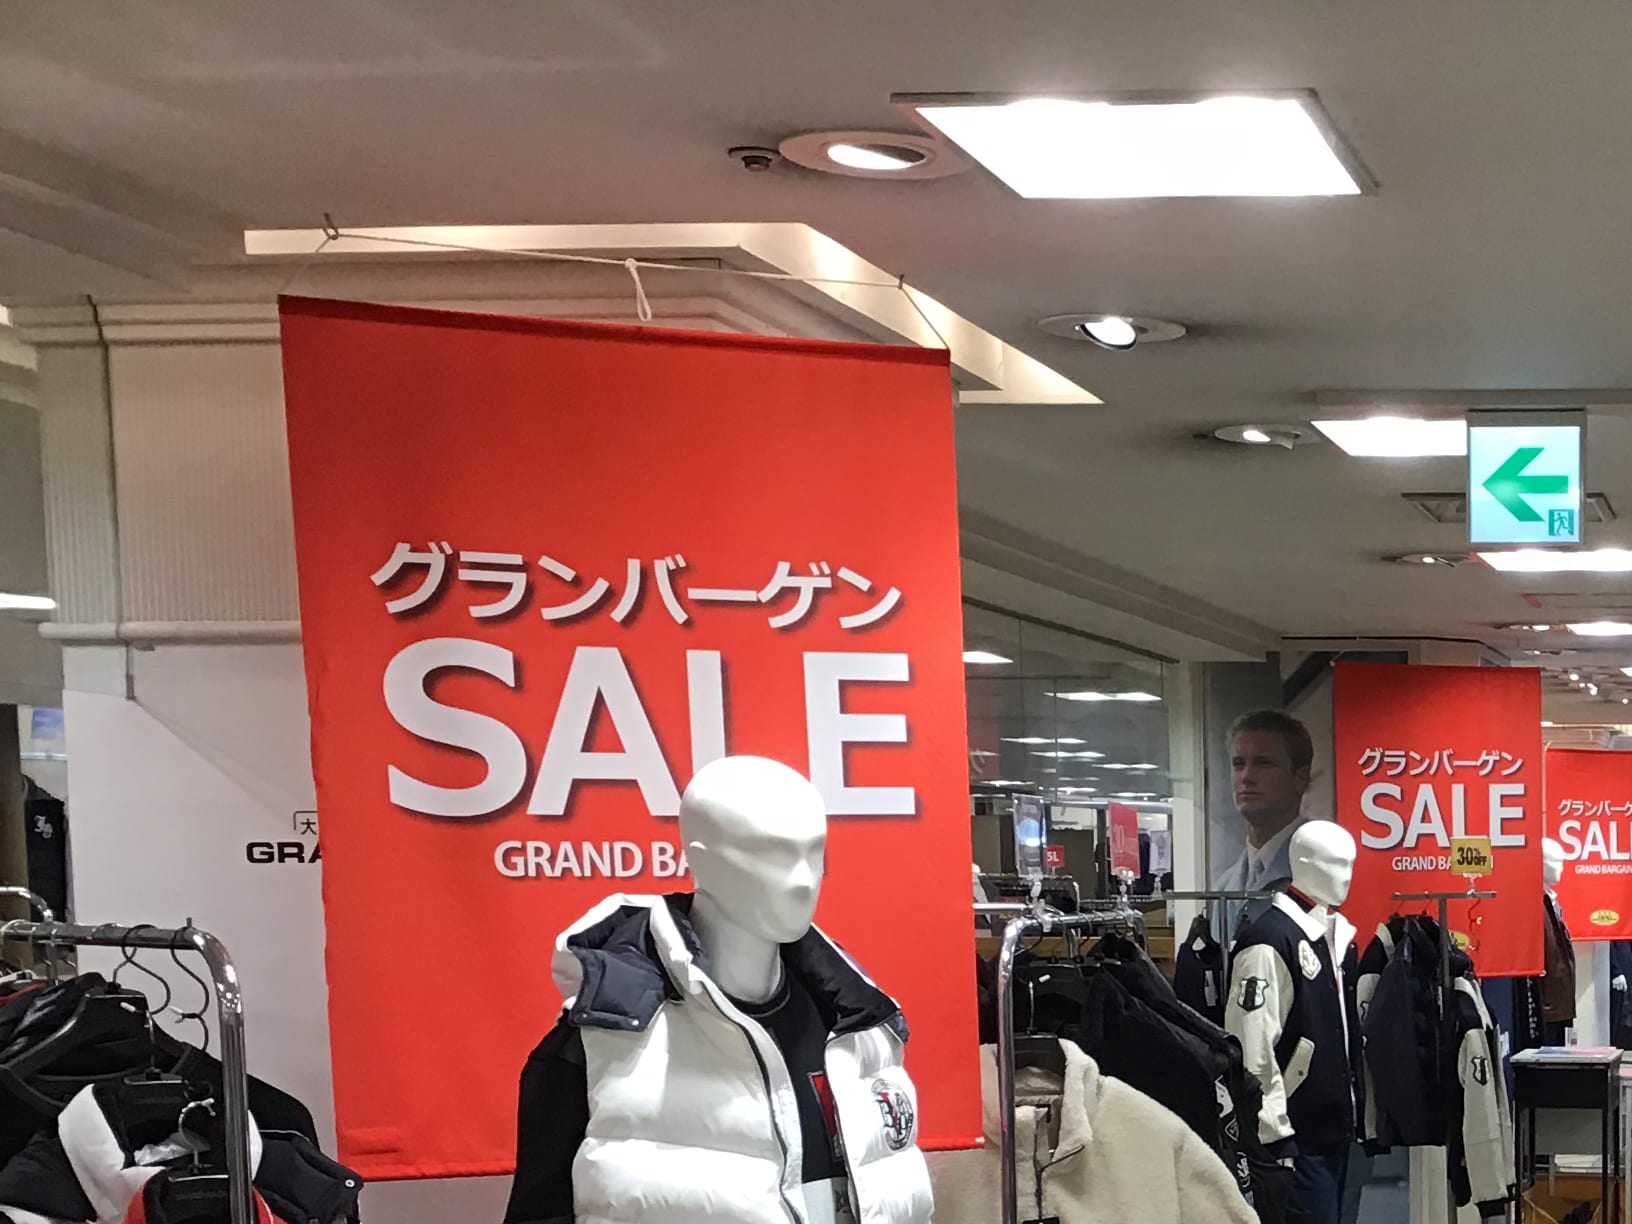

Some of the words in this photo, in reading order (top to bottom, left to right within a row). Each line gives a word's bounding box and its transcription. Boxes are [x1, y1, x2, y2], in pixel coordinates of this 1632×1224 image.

[371, 541, 901, 630] グランバーゲン
[1357, 747, 1523, 777] グランバーゲン
[1360, 782, 1526, 850] SALE
[493, 840, 644, 878] GRAND
[1391, 856, 1437, 871] GRAND
[1574, 864, 1601, 875] GRAND
